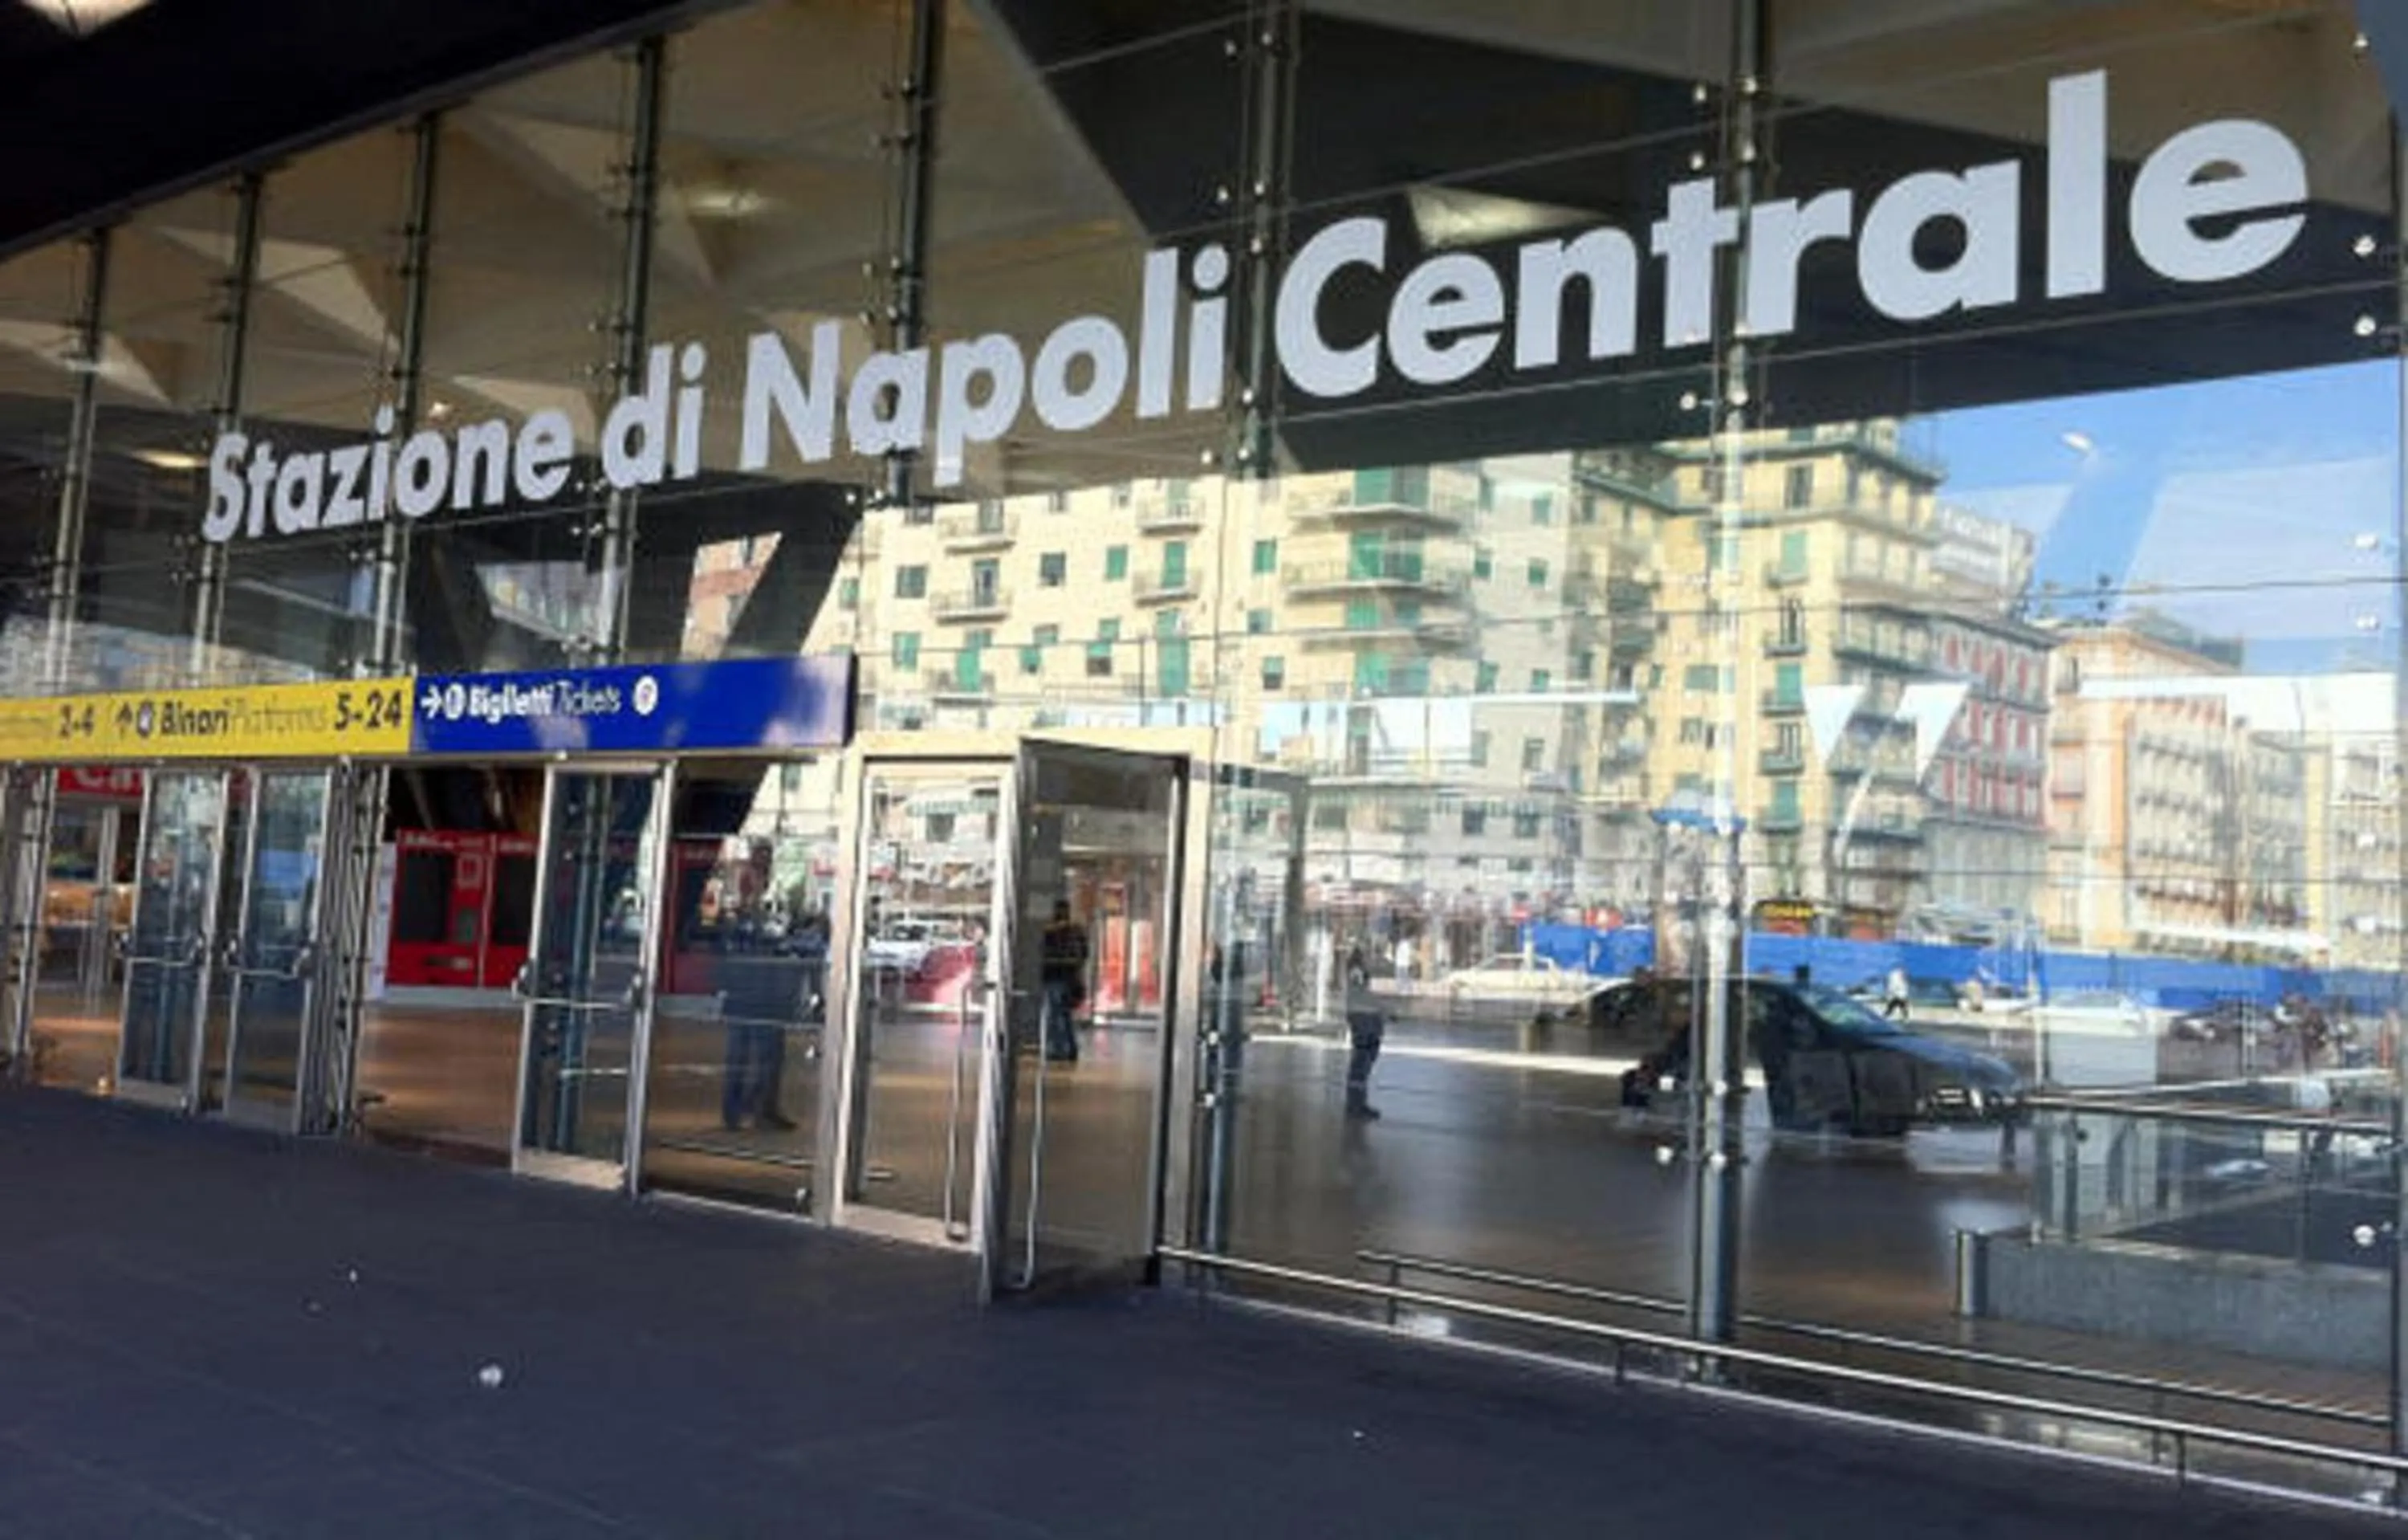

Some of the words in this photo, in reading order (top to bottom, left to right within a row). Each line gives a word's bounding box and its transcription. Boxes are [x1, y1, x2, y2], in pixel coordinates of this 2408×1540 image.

[201, 405, 574, 543] Stazione
[602, 342, 706, 488] di
[741, 244, 1230, 487] Napoli
[1275, 69, 2308, 398] Centrale
[161, 697, 231, 736] Binari
[334, 687, 402, 731] 5-24
[468, 682, 555, 724] Biglietti
